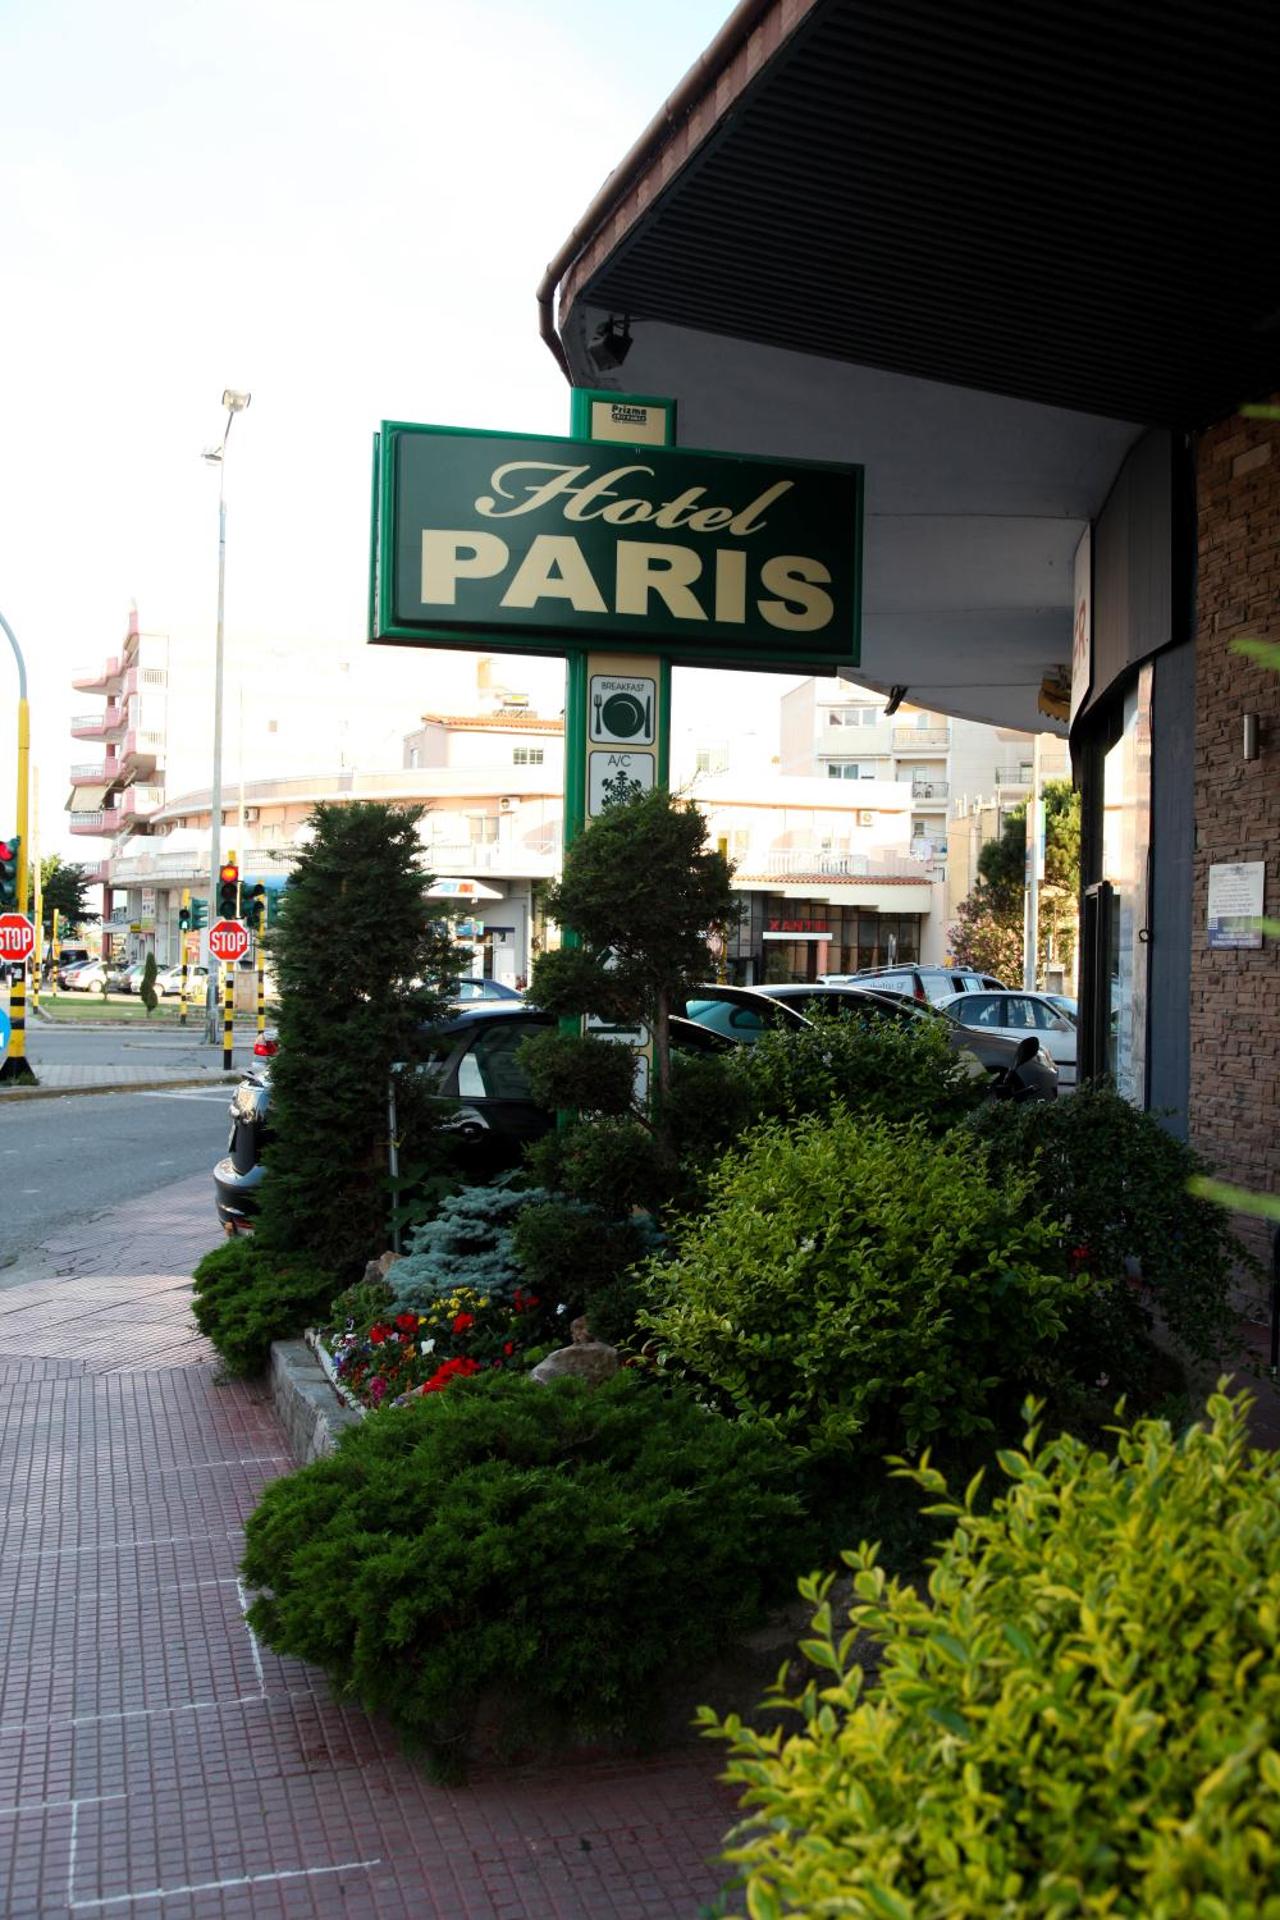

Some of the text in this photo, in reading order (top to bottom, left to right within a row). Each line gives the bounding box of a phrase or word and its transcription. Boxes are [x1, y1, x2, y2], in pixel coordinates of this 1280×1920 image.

[475, 461, 795, 537] Hotel
[421, 529, 835, 632] PARIS
[601, 681, 645, 692] BREAKFAST
[608, 754, 631, 767] A/C
[211, 931, 246, 952] STOP
